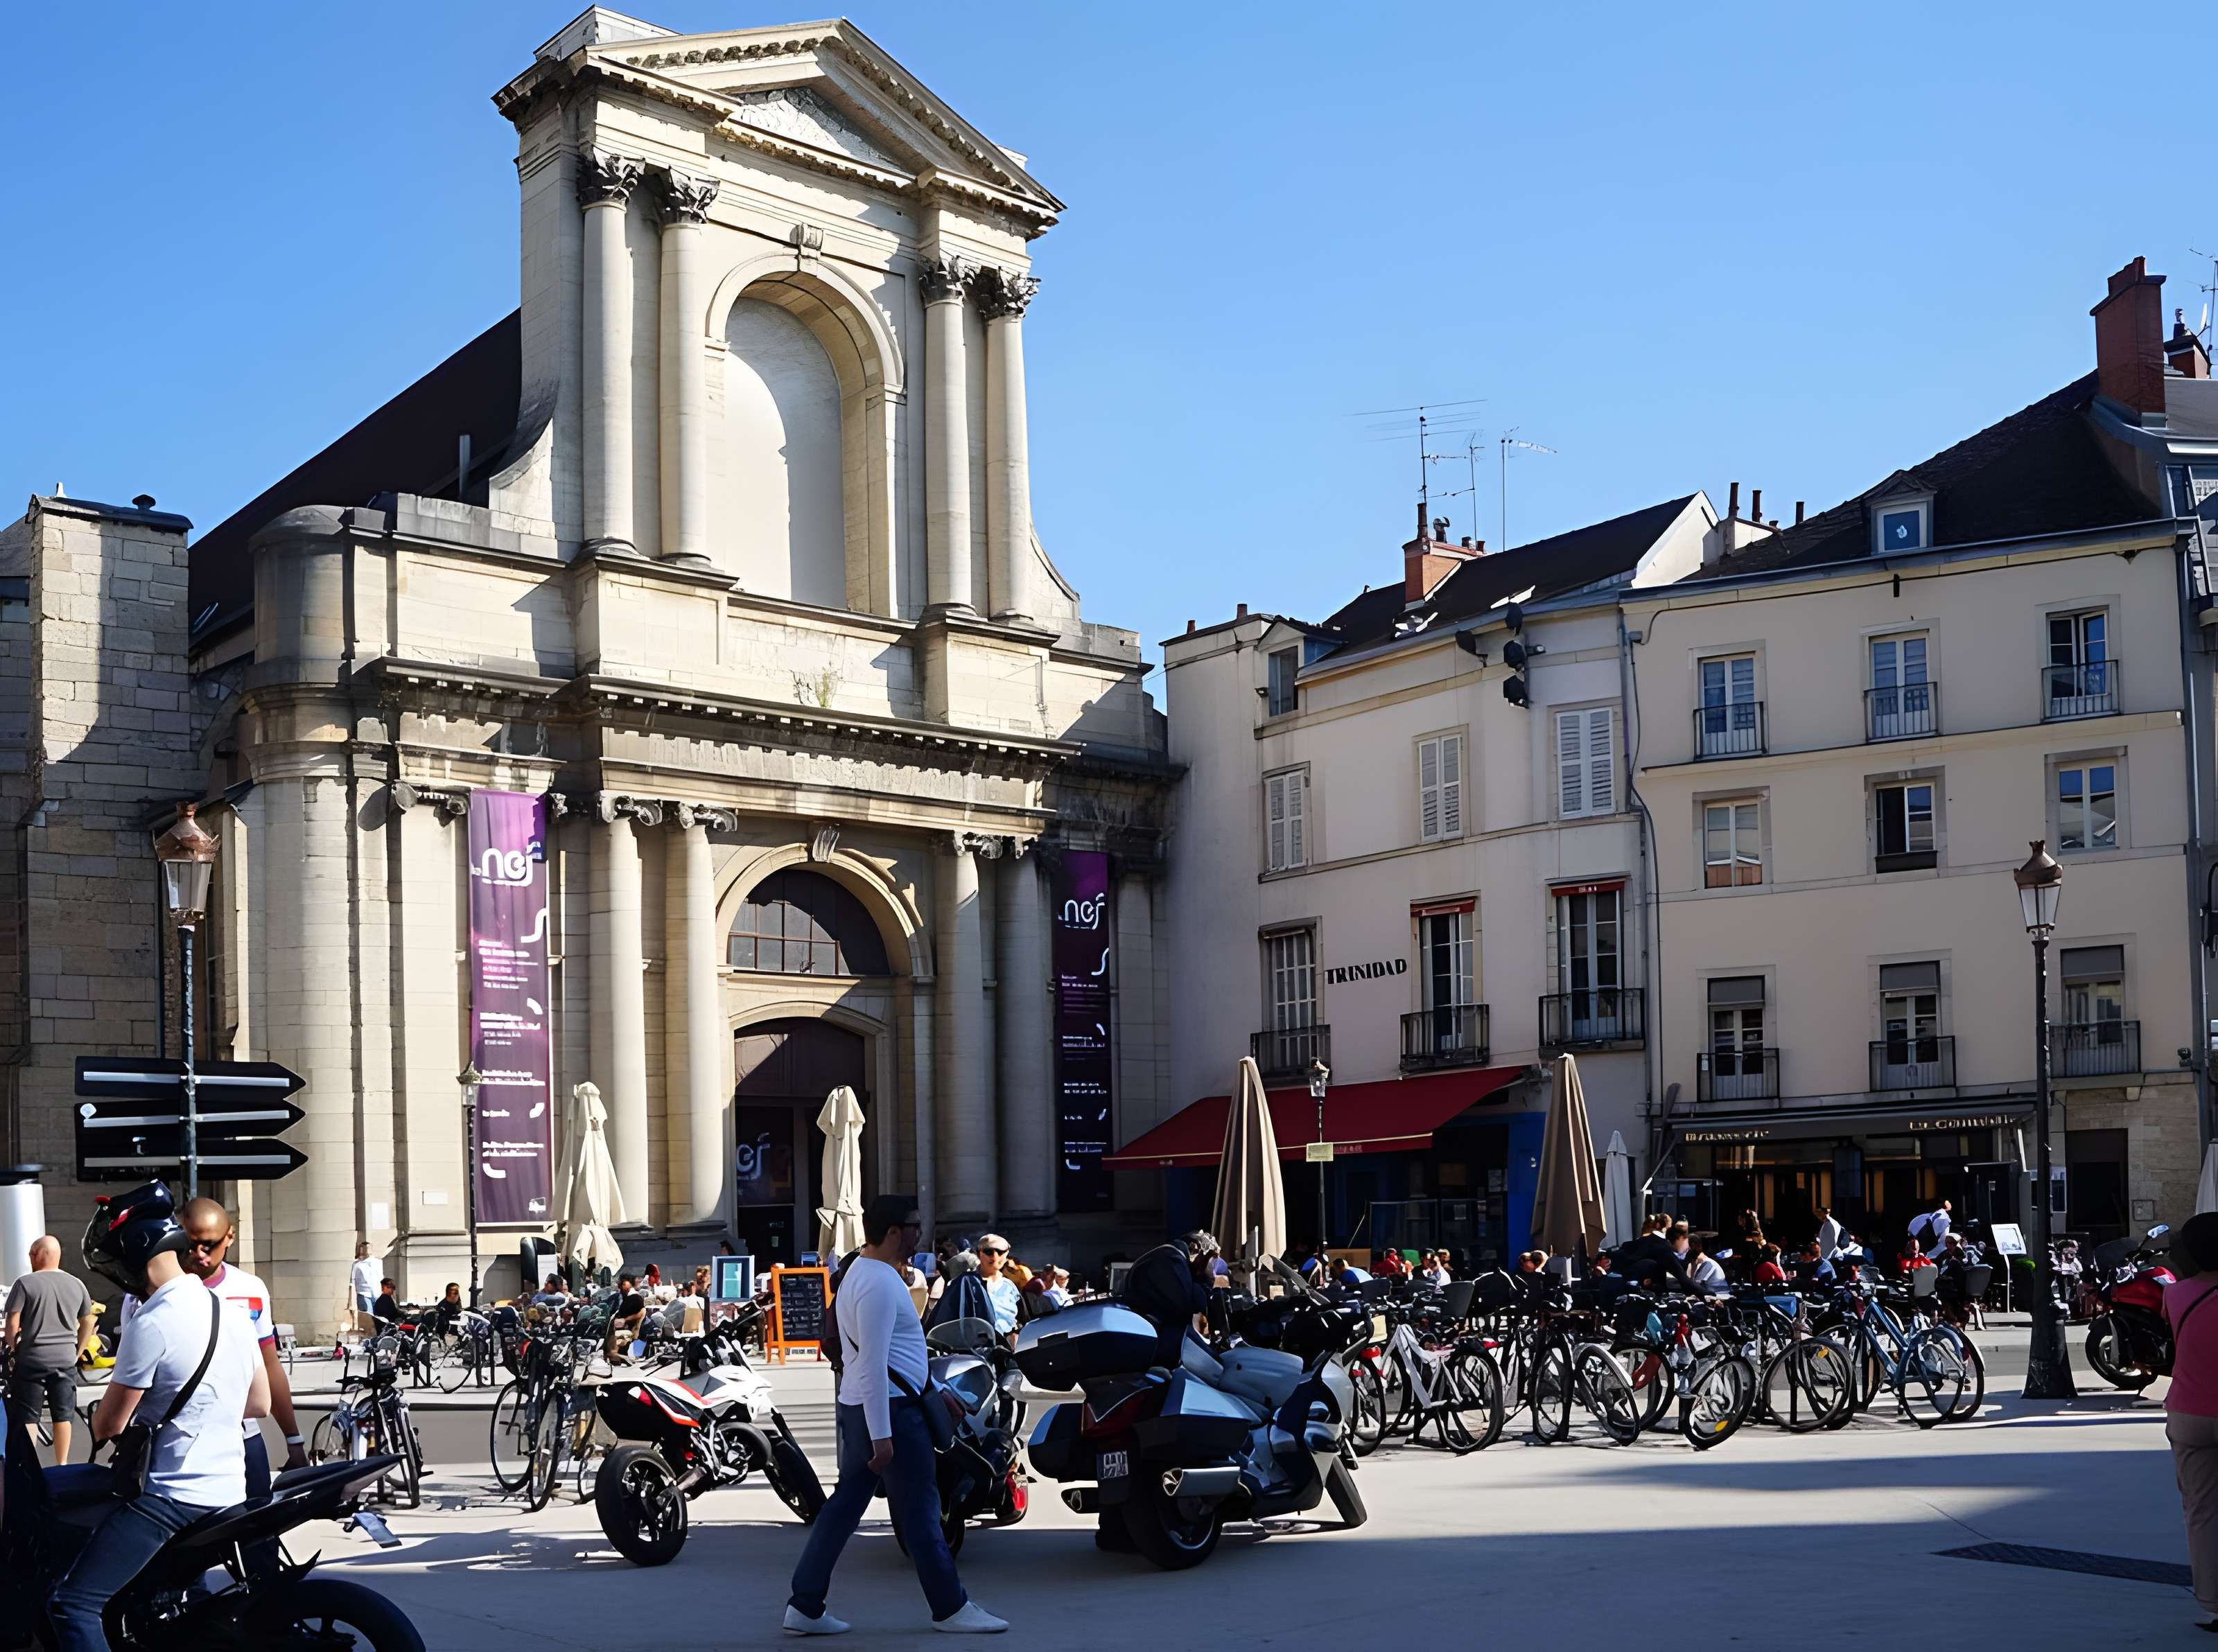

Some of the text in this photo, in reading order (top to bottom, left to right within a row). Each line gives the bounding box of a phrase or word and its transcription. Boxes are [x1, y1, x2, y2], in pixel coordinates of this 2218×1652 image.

[1064, 892, 1106, 930] nef
[1325, 958, 1407, 985] TRINIDAD
[736, 1132, 771, 1180] ef
